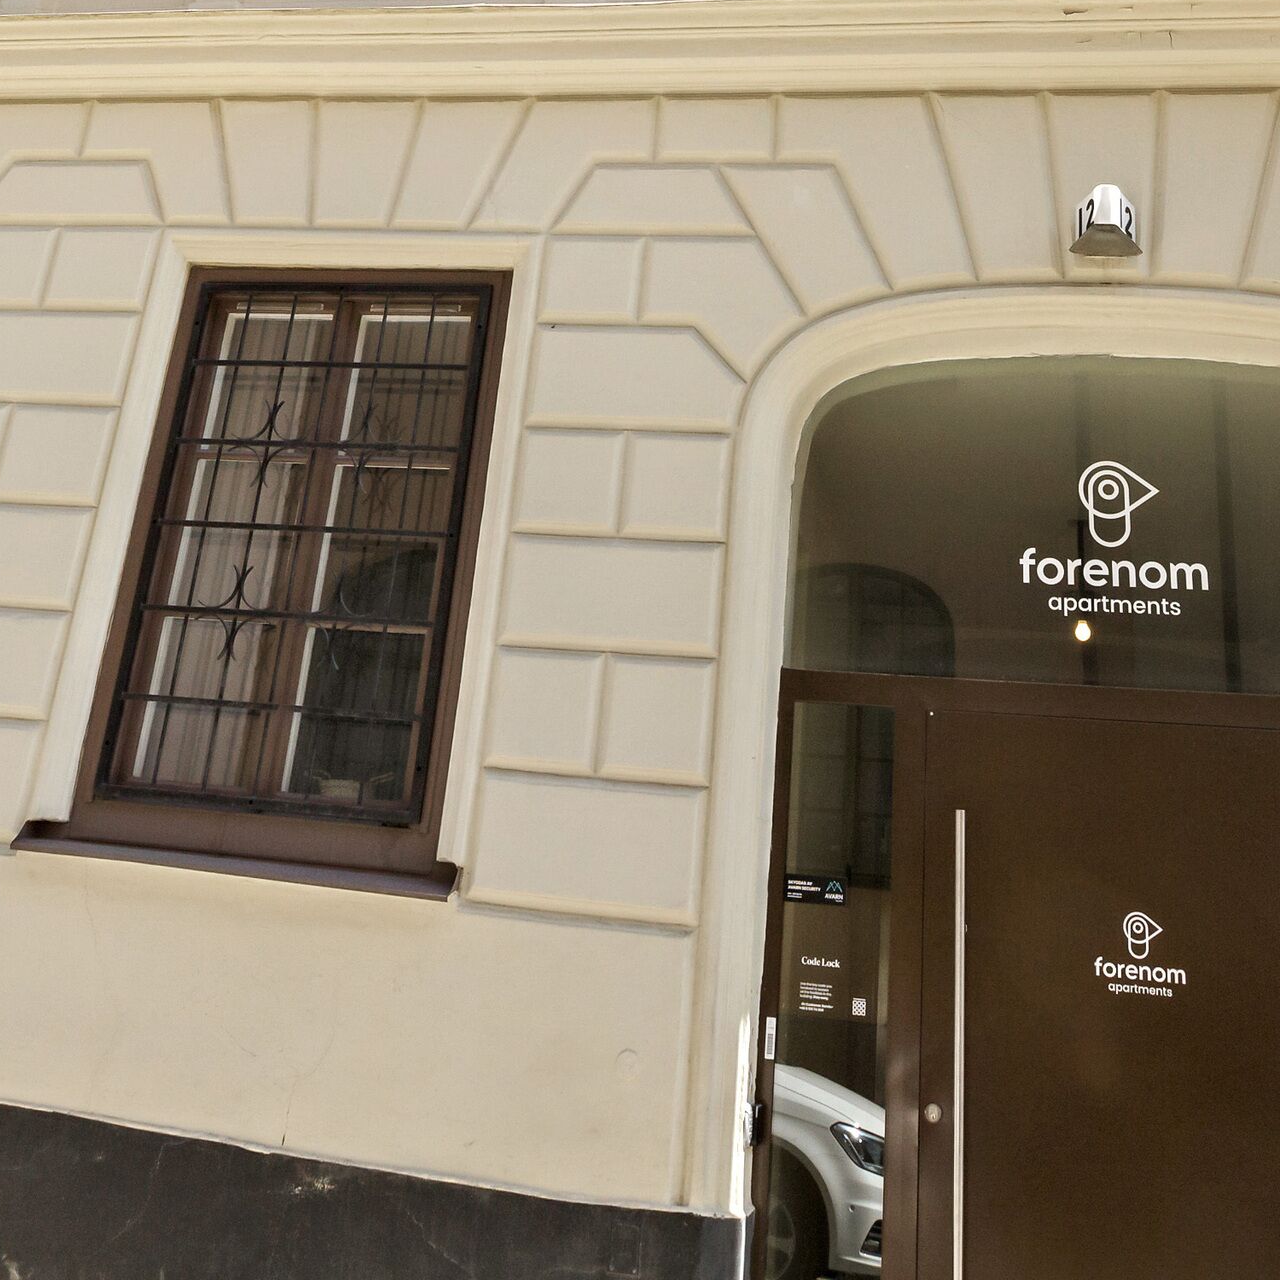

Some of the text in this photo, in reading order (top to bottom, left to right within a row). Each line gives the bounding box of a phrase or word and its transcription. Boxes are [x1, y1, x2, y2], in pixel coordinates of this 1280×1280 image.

[1078, 198, 1095, 239] 12
[1119, 198, 1133, 240] 12
[1019, 547, 1210, 591] forenom
[1048, 595, 1182, 617] apartments
[801, 956, 841, 969] Code Lock
[1094, 956, 1187, 985] forenom
[1108, 983, 1173, 997] apartments
